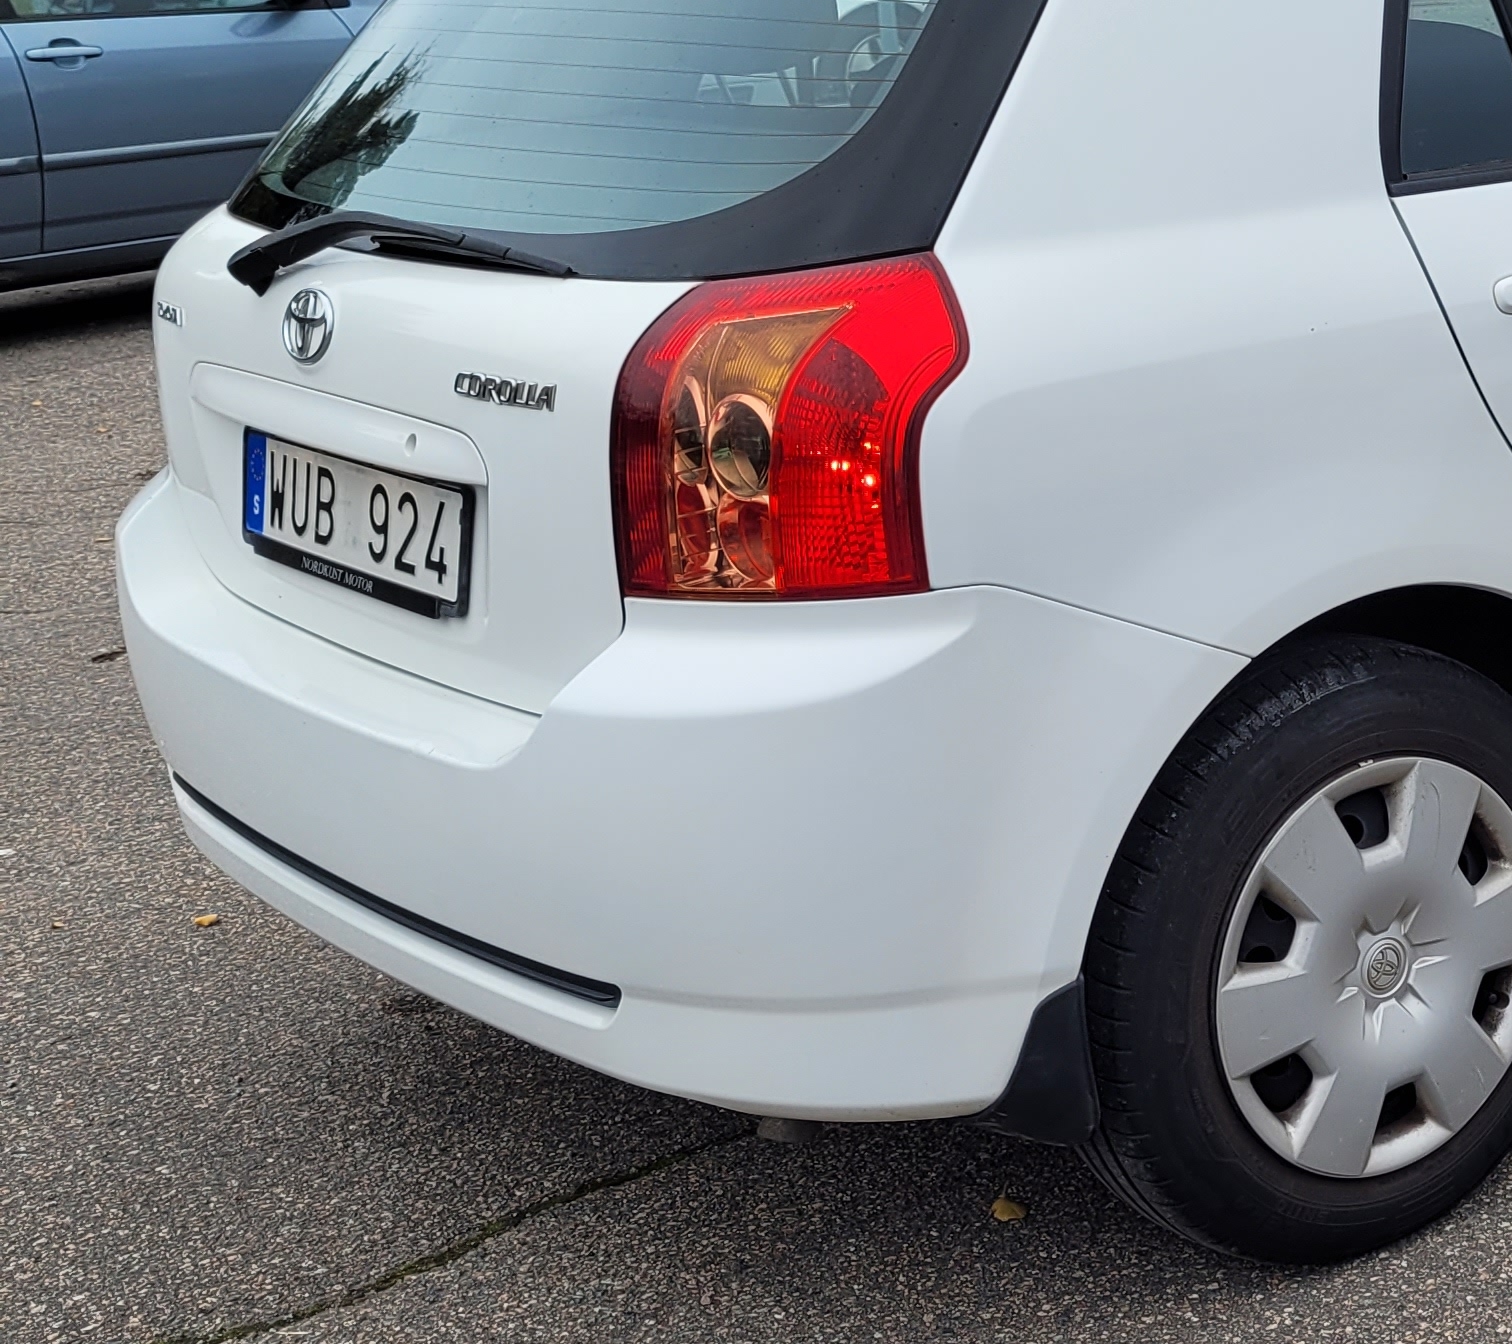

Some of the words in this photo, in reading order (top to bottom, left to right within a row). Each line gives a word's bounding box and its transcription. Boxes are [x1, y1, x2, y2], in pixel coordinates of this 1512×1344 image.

[454, 371, 557, 412] COROLLA
[253, 495, 260, 515] S
[269, 450, 335, 545] WUB
[368, 483, 447, 584] 924
[301, 555, 344, 582] NORDKUST
[343, 571, 373, 593] MOTOR
